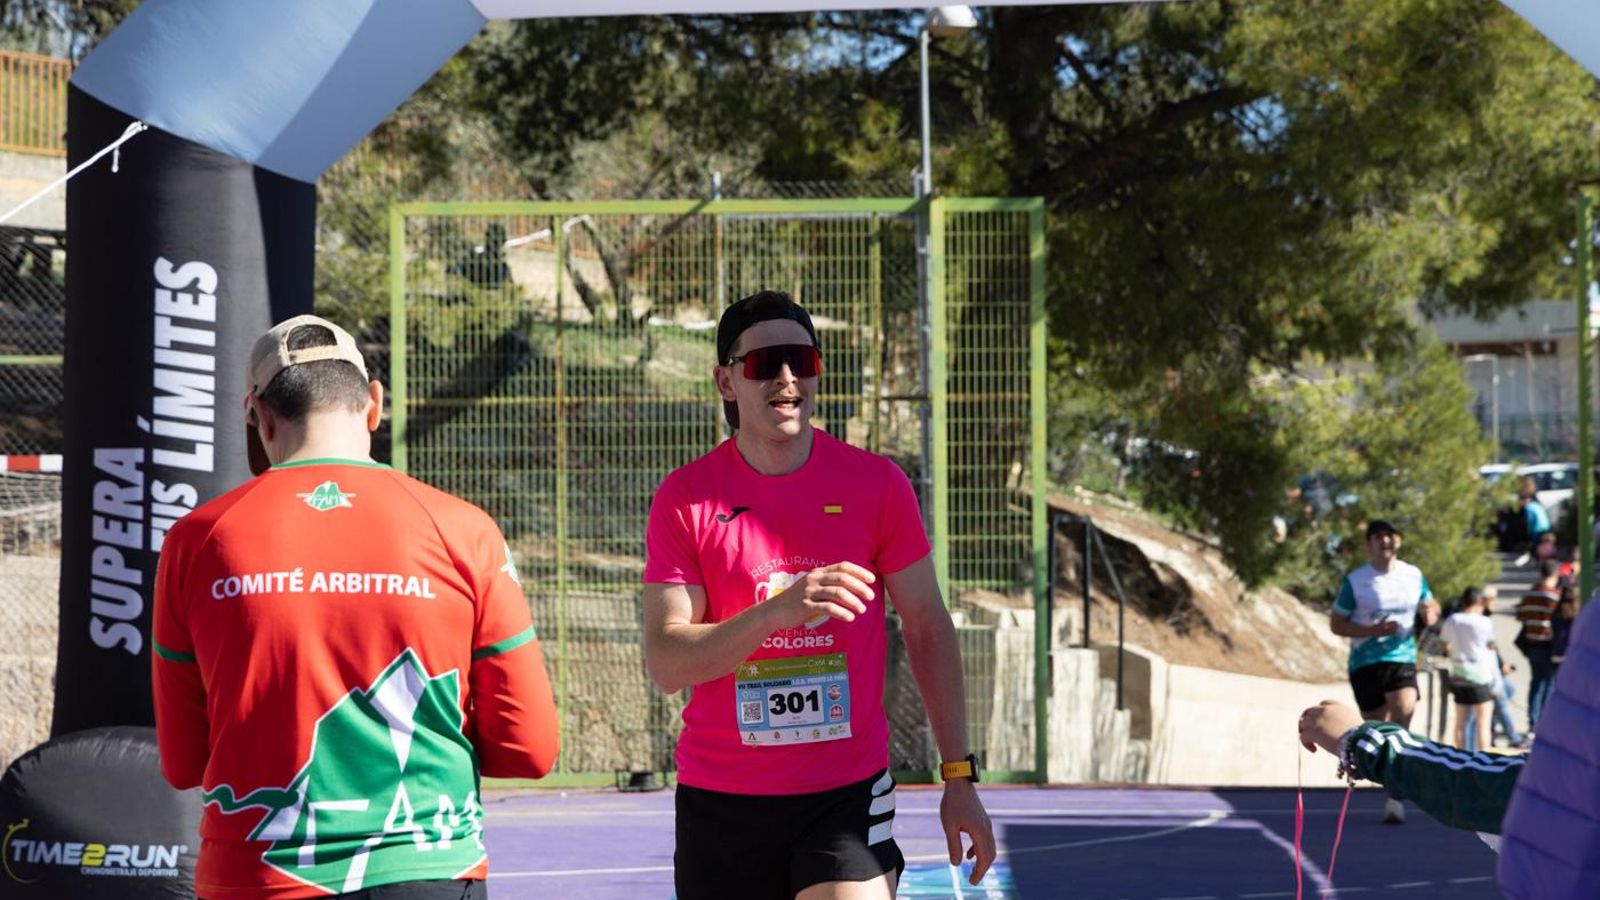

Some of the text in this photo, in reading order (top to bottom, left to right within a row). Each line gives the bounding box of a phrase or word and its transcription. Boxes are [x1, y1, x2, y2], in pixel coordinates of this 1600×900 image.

[137, 256, 218, 472] LÍMITES
[90, 448, 144, 656] SUPERA
[211, 567, 436, 600] COMITÉ ARBITRAL
[761, 635, 834, 649] COLORES
[769, 690, 820, 715] 301
